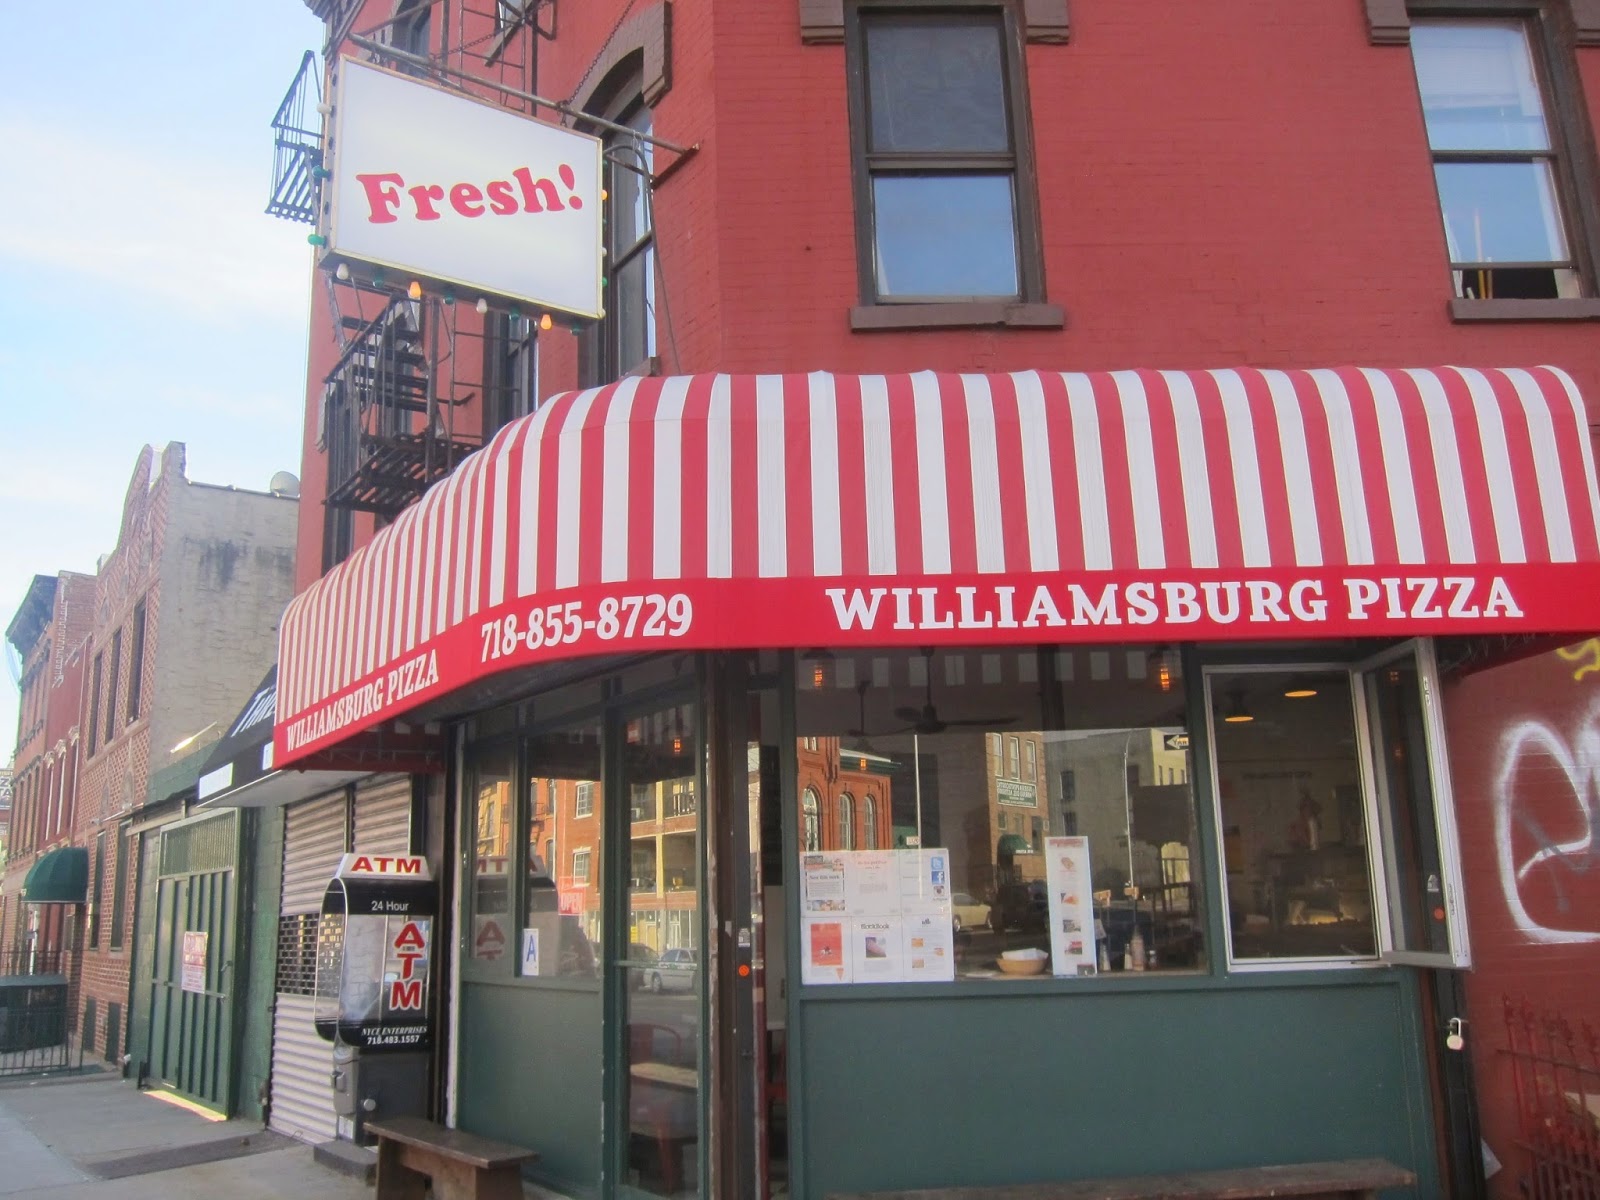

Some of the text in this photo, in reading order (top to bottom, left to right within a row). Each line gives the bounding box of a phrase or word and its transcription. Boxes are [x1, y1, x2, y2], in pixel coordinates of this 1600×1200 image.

[356, 163, 583, 225] Fresh!
[480, 593, 693, 664] 718-855-8729
[825, 575, 1524, 630] WILLIAMSBURG PIZZA
[287, 648, 439, 753] WILLIAMSBURG PIZZA
[351, 856, 422, 874] ATM
[371, 900, 409, 912] 24 Hour
[391, 922, 426, 1009] ATM
[526, 934, 536, 962] A
[361, 1025, 428, 1036] NYCE ENTERPRISES
